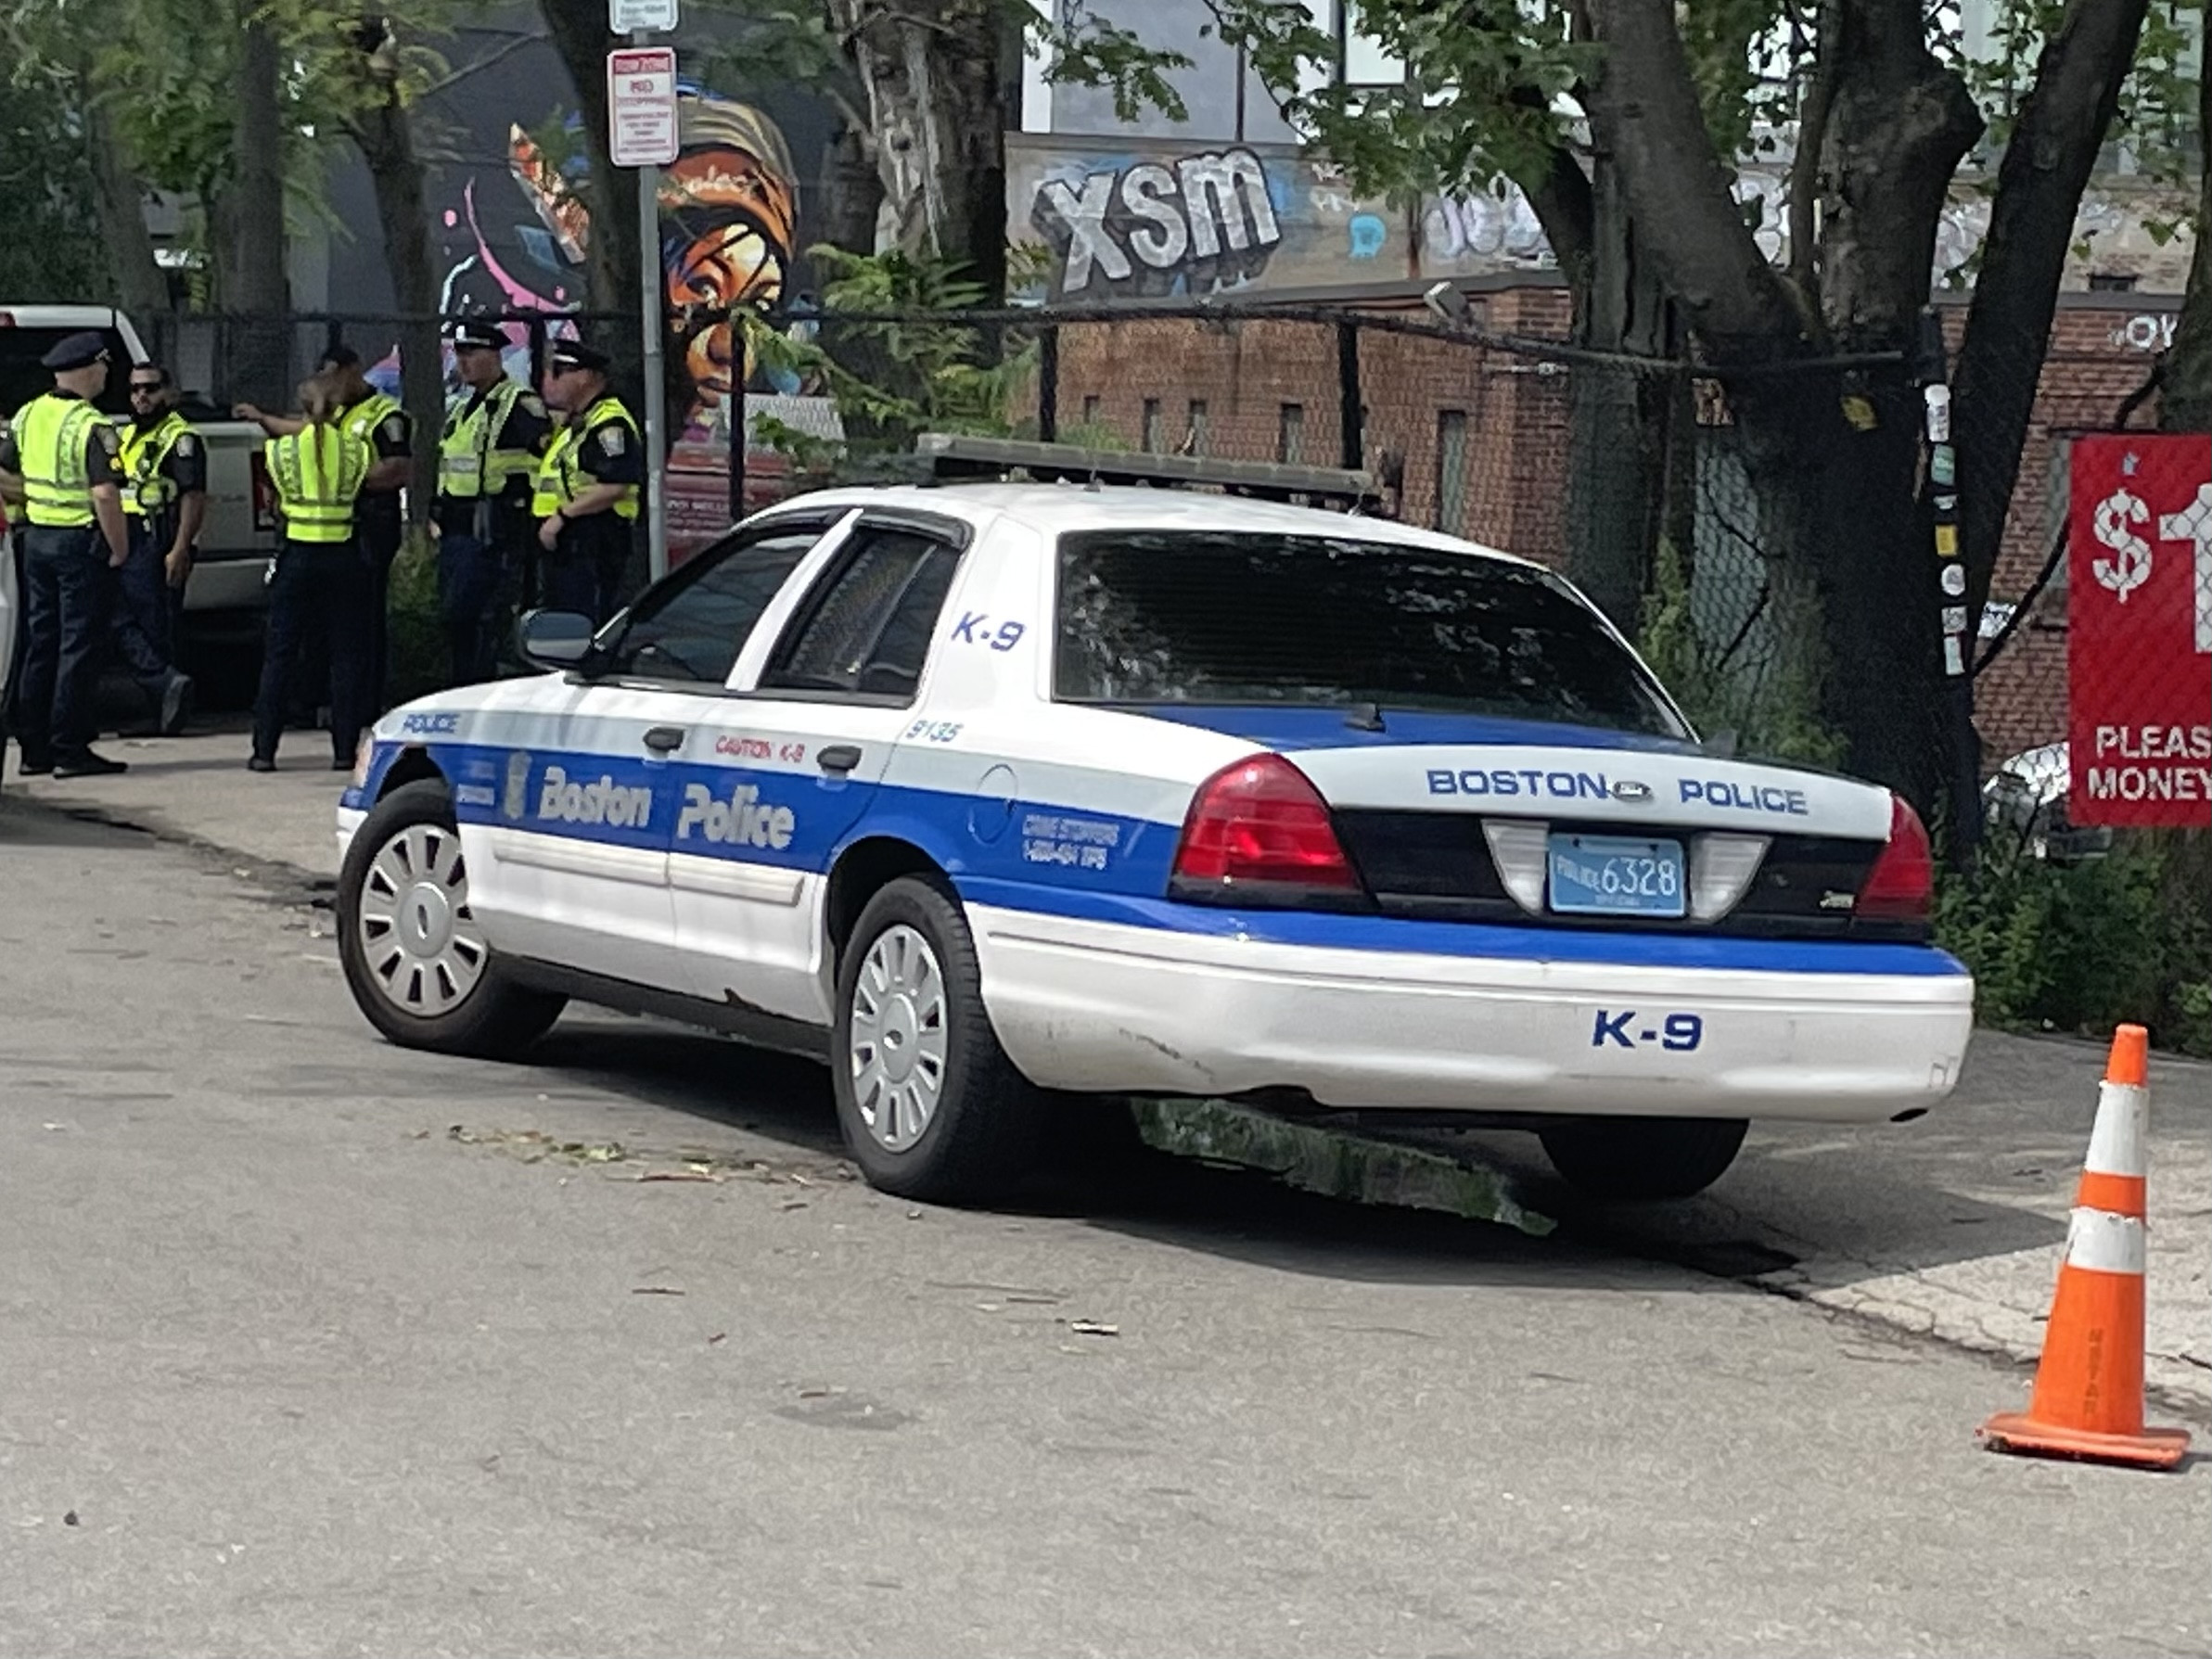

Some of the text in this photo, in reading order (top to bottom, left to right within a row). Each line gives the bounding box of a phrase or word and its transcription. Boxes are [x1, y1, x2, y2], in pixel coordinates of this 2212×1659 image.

[951, 611, 1026, 651] K-9
[403, 713, 460, 734] POLICE
[536, 765, 795, 849] Boston Police
[1427, 769, 1809, 814] BOSTON POLICE
[1601, 856, 1677, 896] 6328
[1592, 1009, 1705, 1052] K-9
